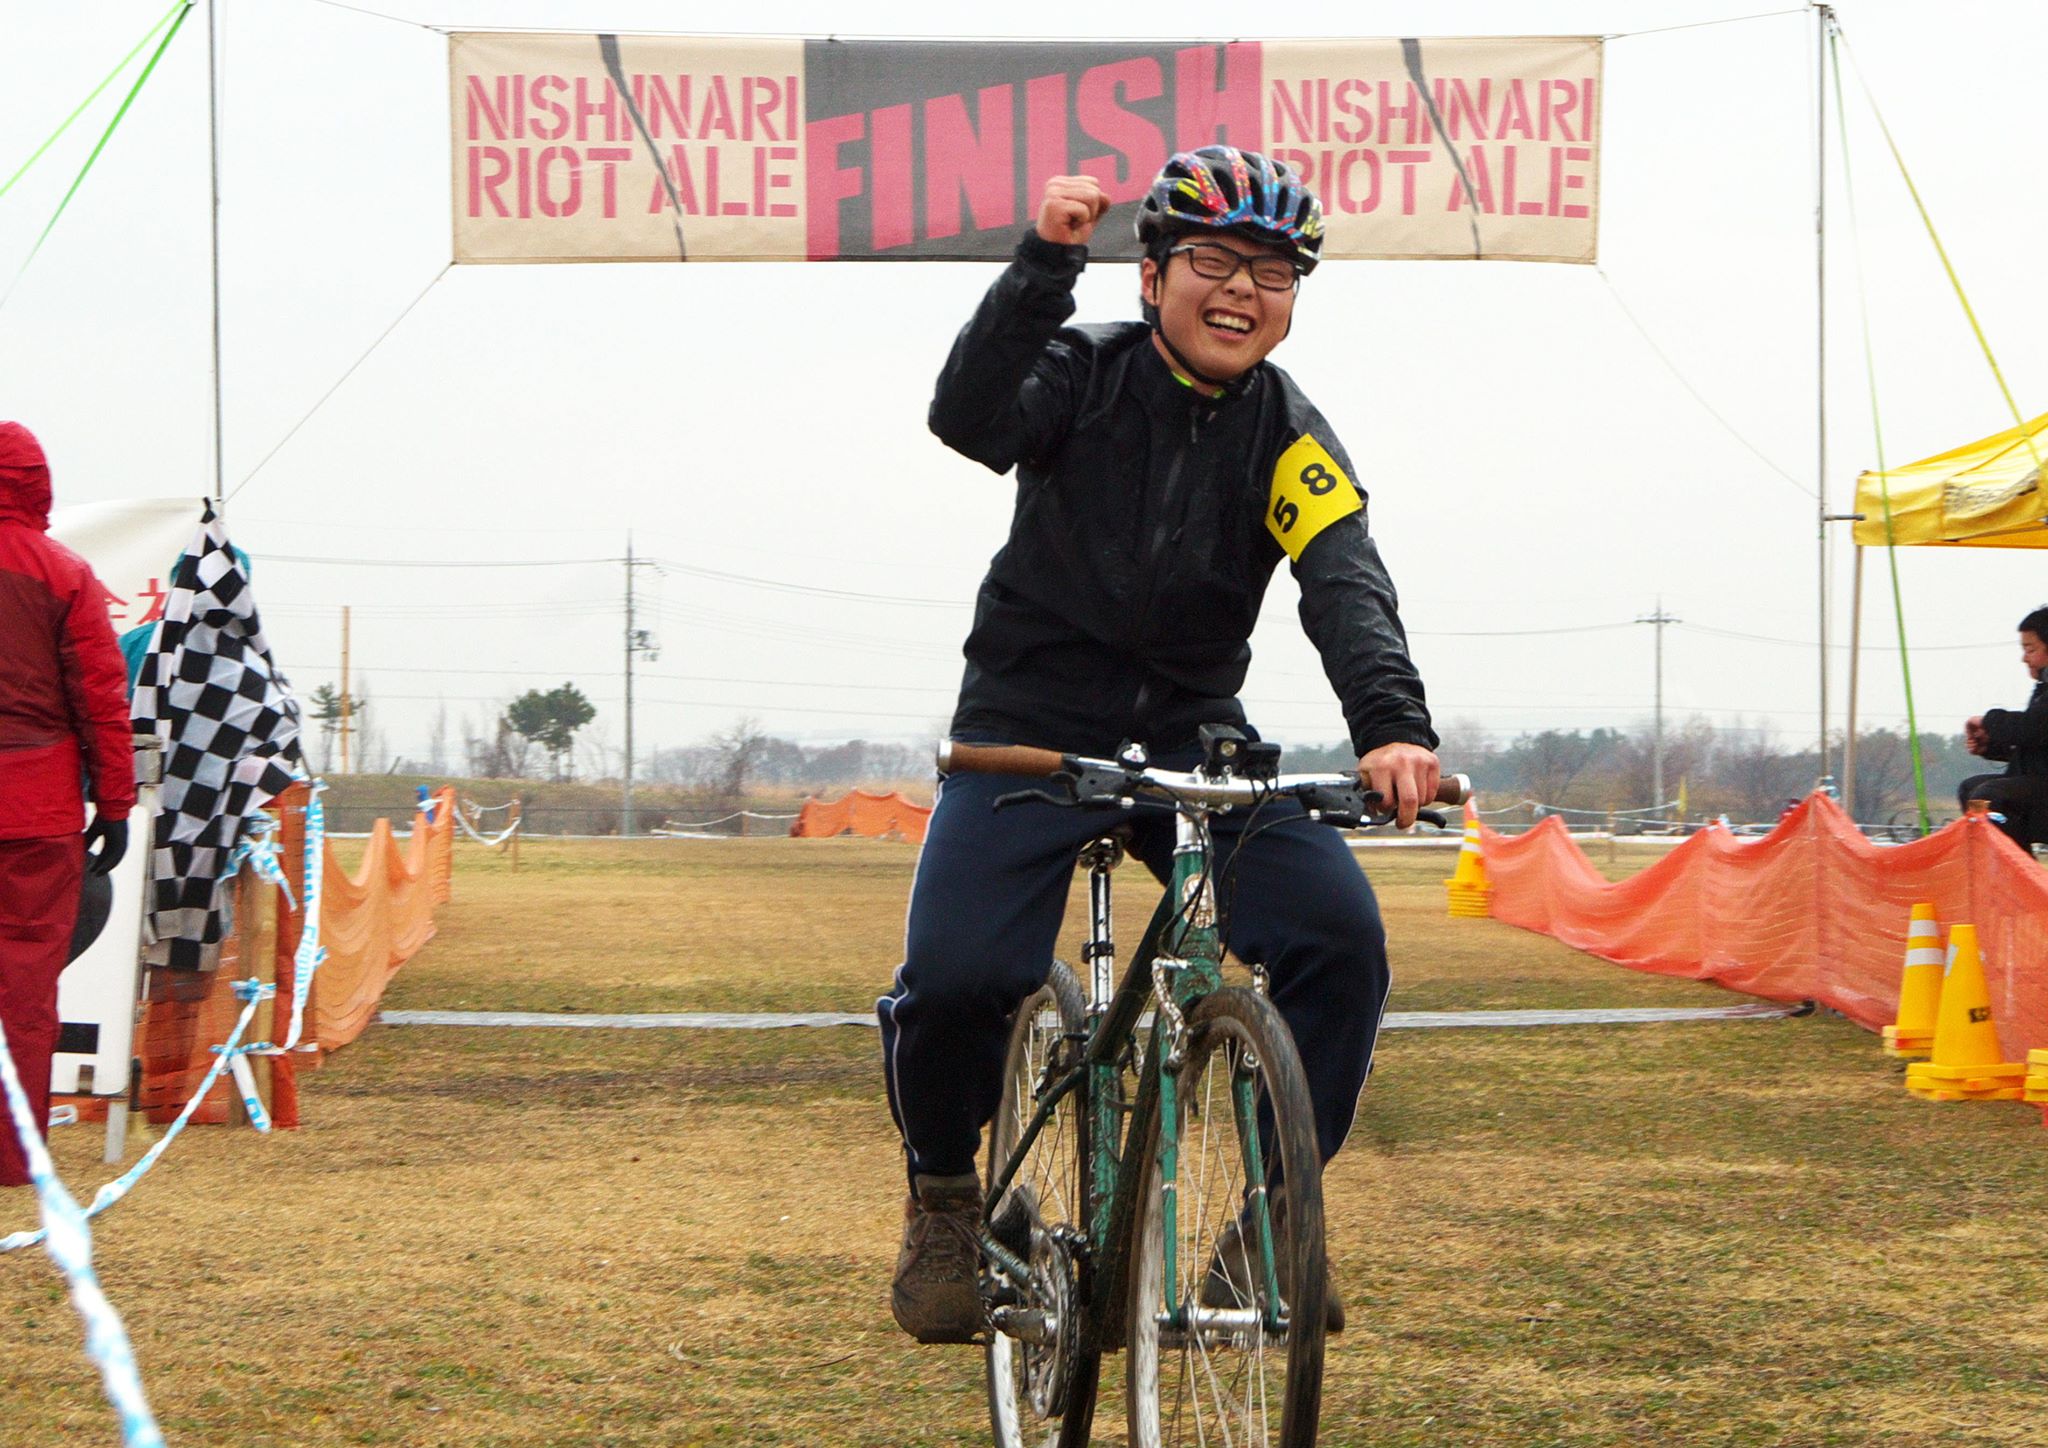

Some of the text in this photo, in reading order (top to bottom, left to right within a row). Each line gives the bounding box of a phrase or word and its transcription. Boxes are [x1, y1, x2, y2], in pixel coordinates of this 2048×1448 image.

[466, 74, 798, 141] NISHINARI
[1271, 77, 1595, 145] NISHINARI
[467, 143, 798, 219] RIOT ALE
[805, 41, 1262, 261] FINISH
[1446, 145, 1591, 218] ALE
